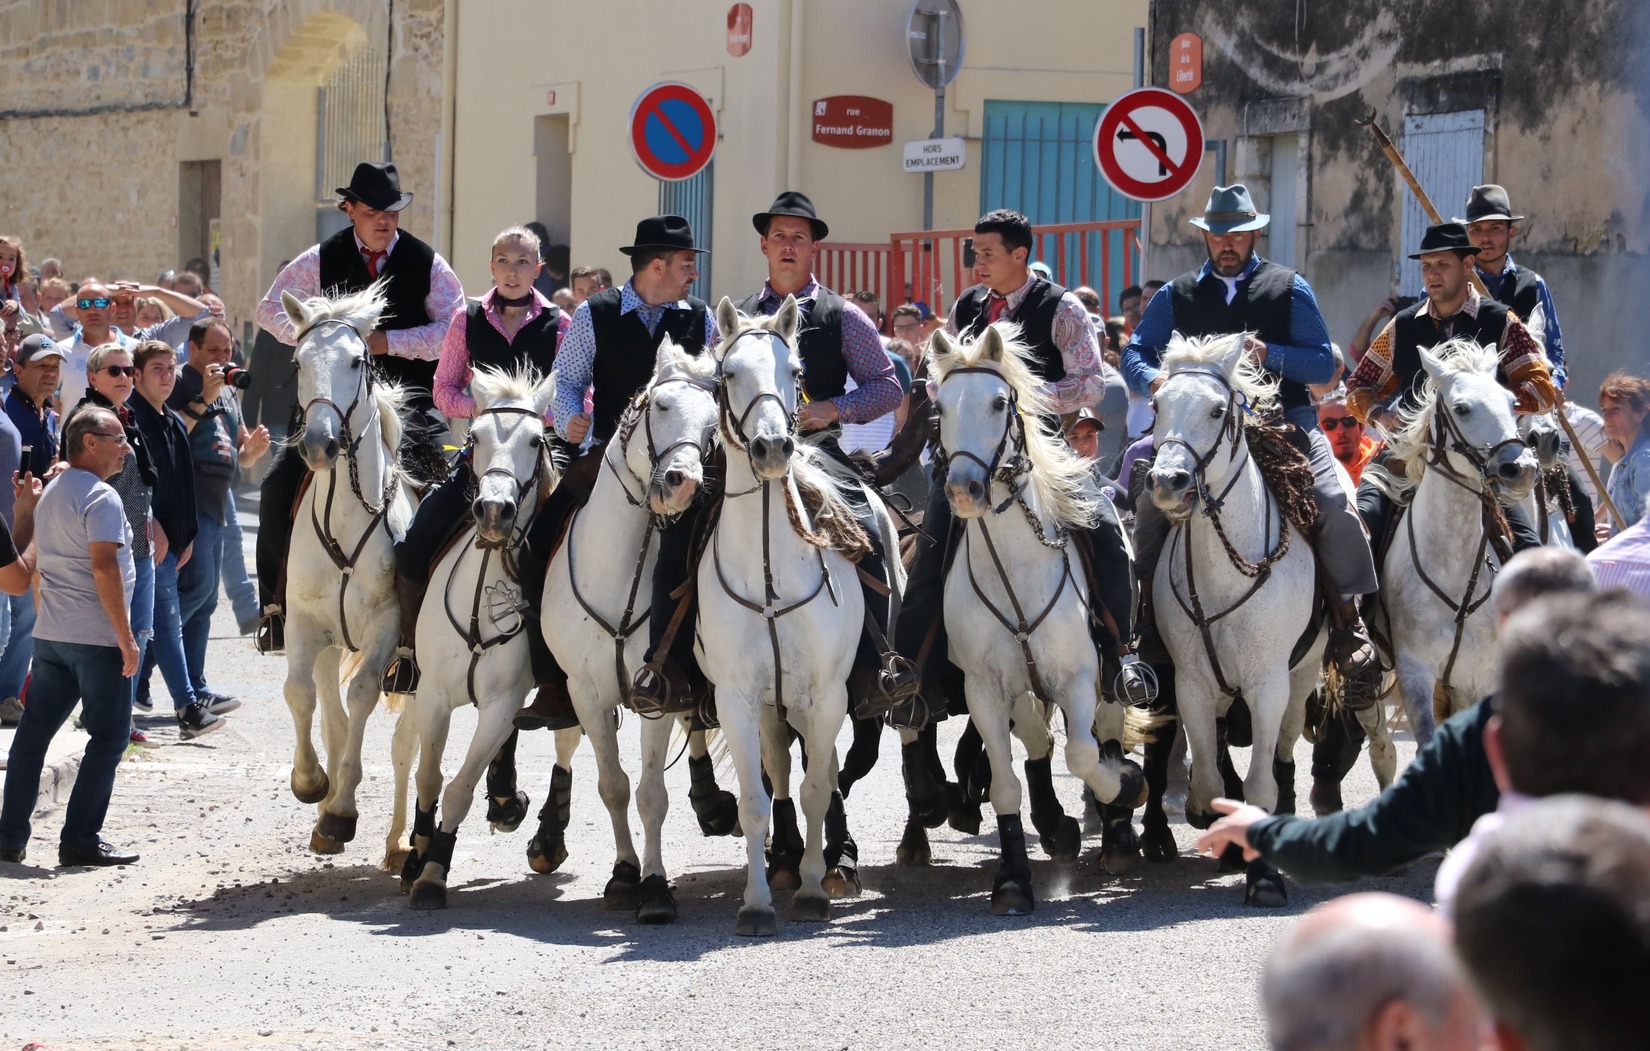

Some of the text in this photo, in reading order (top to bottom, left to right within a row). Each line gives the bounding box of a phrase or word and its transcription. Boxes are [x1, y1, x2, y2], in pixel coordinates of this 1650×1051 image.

[1177, 68, 1194, 82] Liberté
[846, 108, 860, 116] rue
[816, 124, 890, 136] Fernand Granon
[923, 145, 942, 154] HORS
[905, 156, 960, 168] EMPLACEMENT
